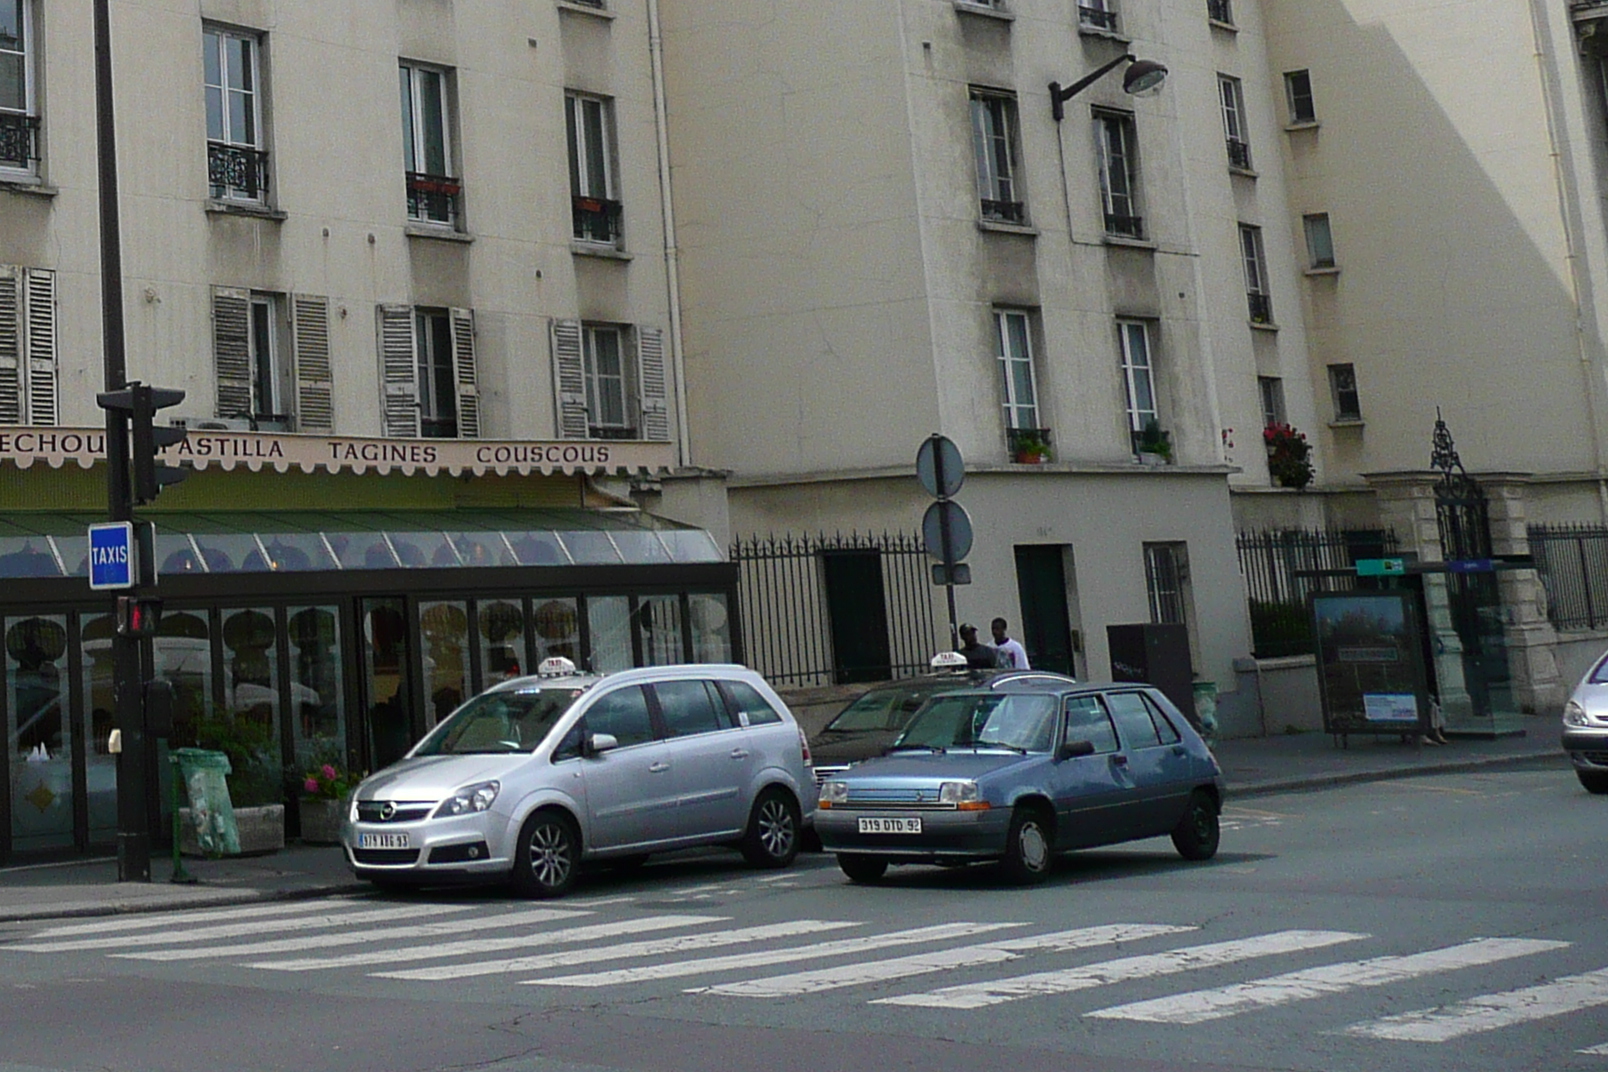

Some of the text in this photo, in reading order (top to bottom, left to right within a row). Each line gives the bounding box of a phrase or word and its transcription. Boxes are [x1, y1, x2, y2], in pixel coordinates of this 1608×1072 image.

[329, 441, 438, 463] TAGINES
[476, 445, 610, 464] COUSCOUS
[92, 545, 127, 565] TAXIS
[861, 819, 880, 832] 319
[907, 819, 920, 832] 92
